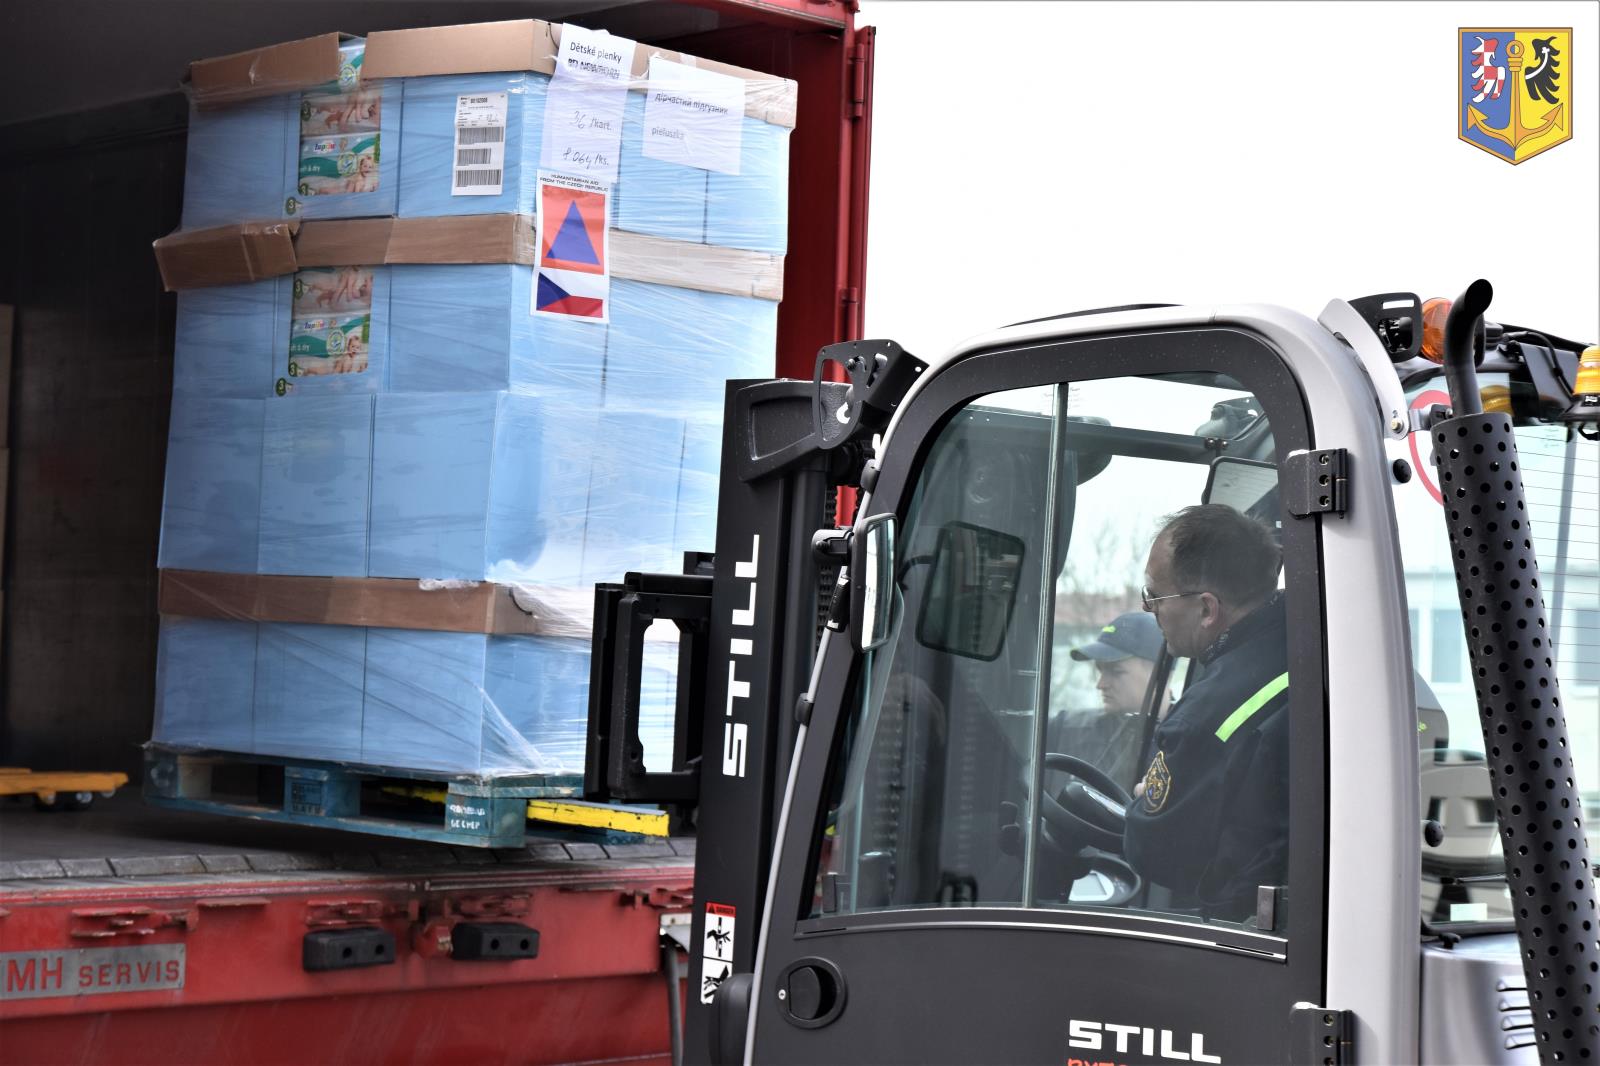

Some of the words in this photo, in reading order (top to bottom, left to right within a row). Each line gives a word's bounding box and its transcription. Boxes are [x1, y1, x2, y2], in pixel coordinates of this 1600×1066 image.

[597, 49, 622, 65] plenky
[551, 174, 589, 184] HUMANITARIAN
[584, 184, 609, 192] REPUBLIC
[722, 534, 760, 778] STILL
[79, 959, 180, 987] SERVIS
[1068, 1019, 1222, 1064] STILL
